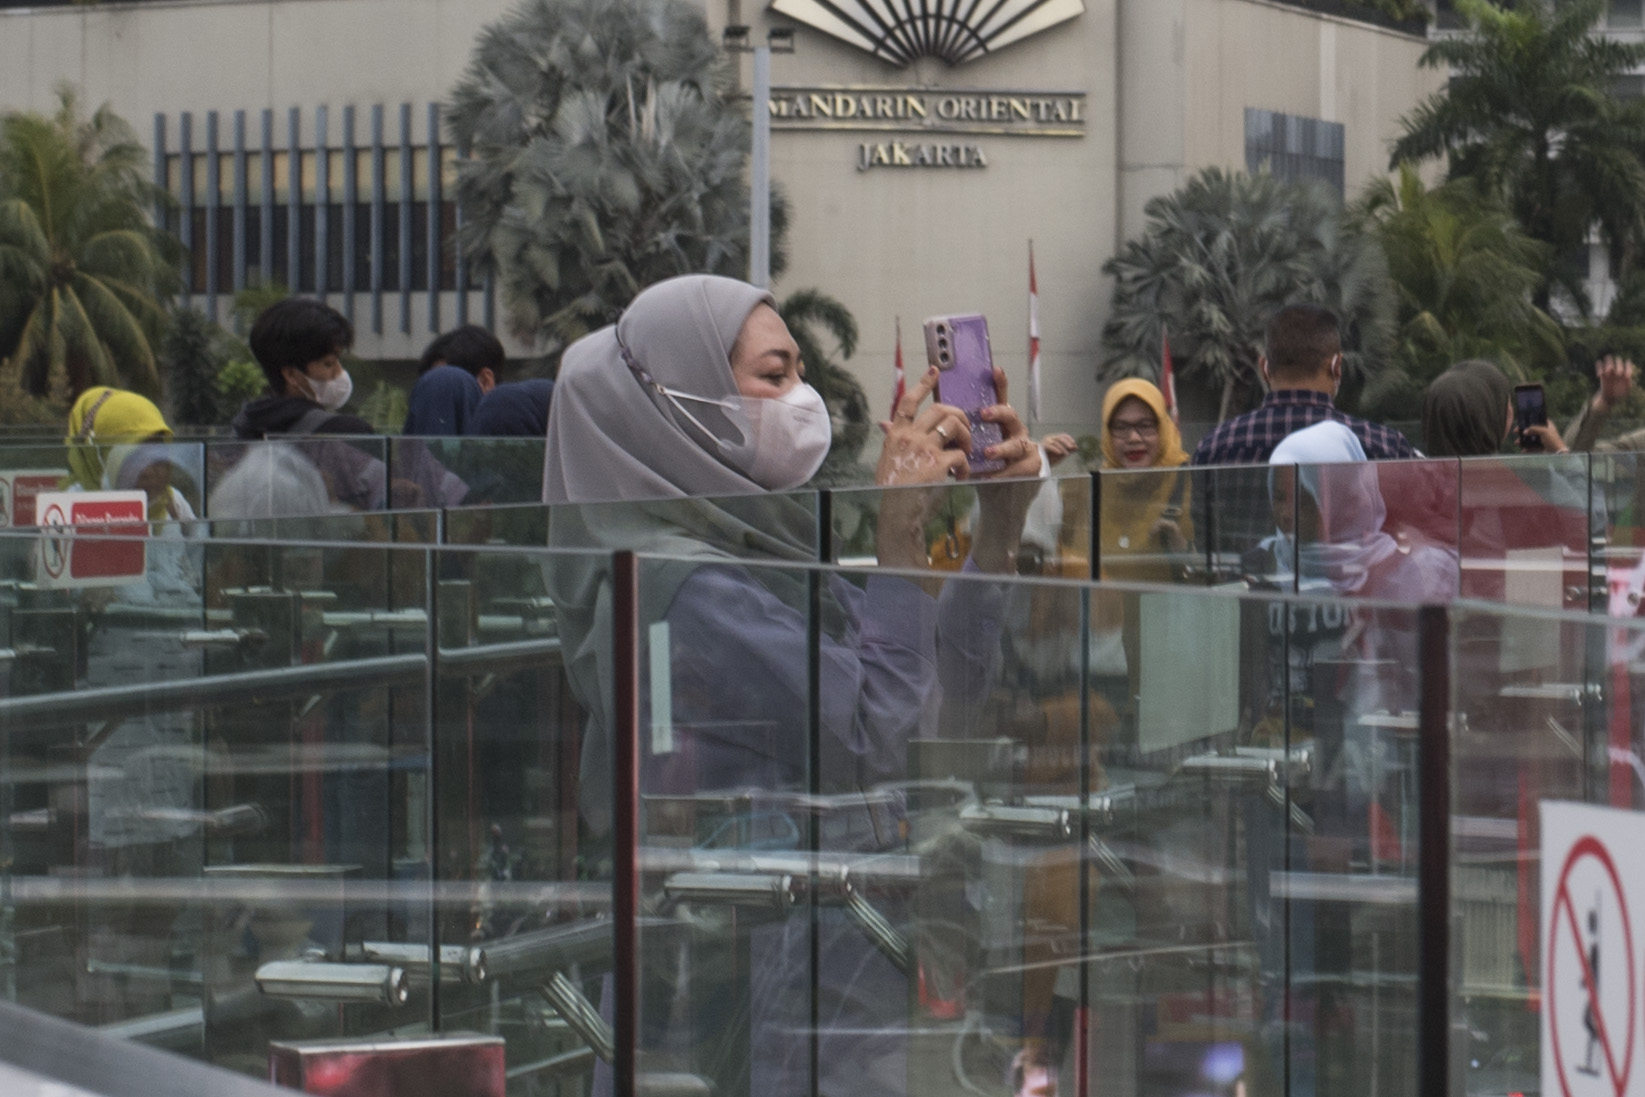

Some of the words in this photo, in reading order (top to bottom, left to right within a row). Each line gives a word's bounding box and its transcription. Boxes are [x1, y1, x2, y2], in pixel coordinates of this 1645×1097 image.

[769, 93, 926, 120] MANDARIN
[936, 95, 1083, 122] ORIENTAL
[857, 142, 988, 171] JAKARTA
